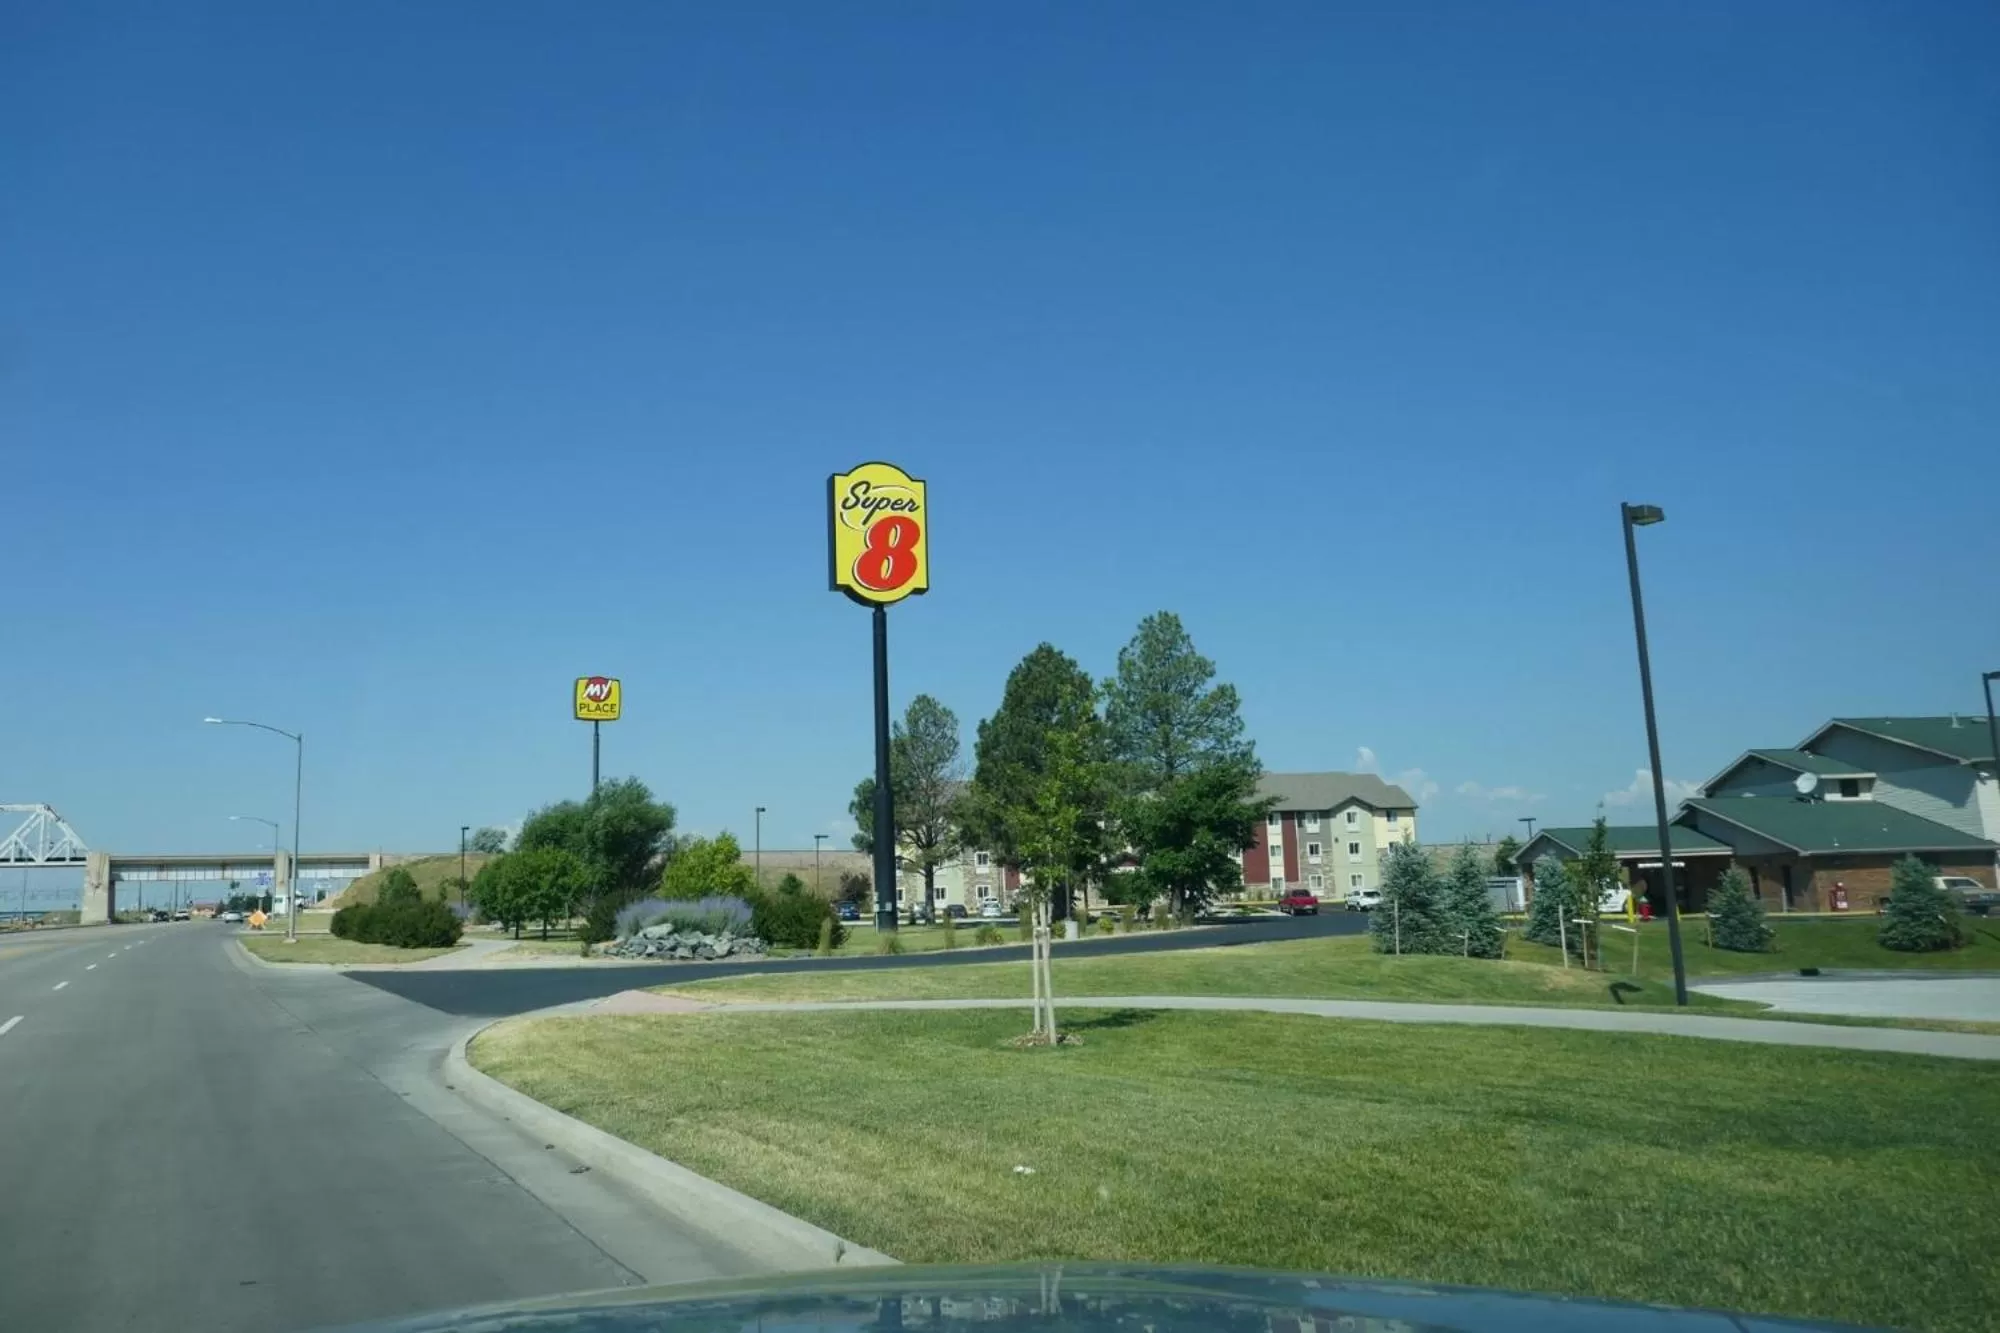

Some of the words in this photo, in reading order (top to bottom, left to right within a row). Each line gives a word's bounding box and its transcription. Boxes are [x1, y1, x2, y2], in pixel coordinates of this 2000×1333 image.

[841, 480, 920, 526] Super
[852, 515, 921, 592] 8
[579, 703, 617, 713] PLACE
